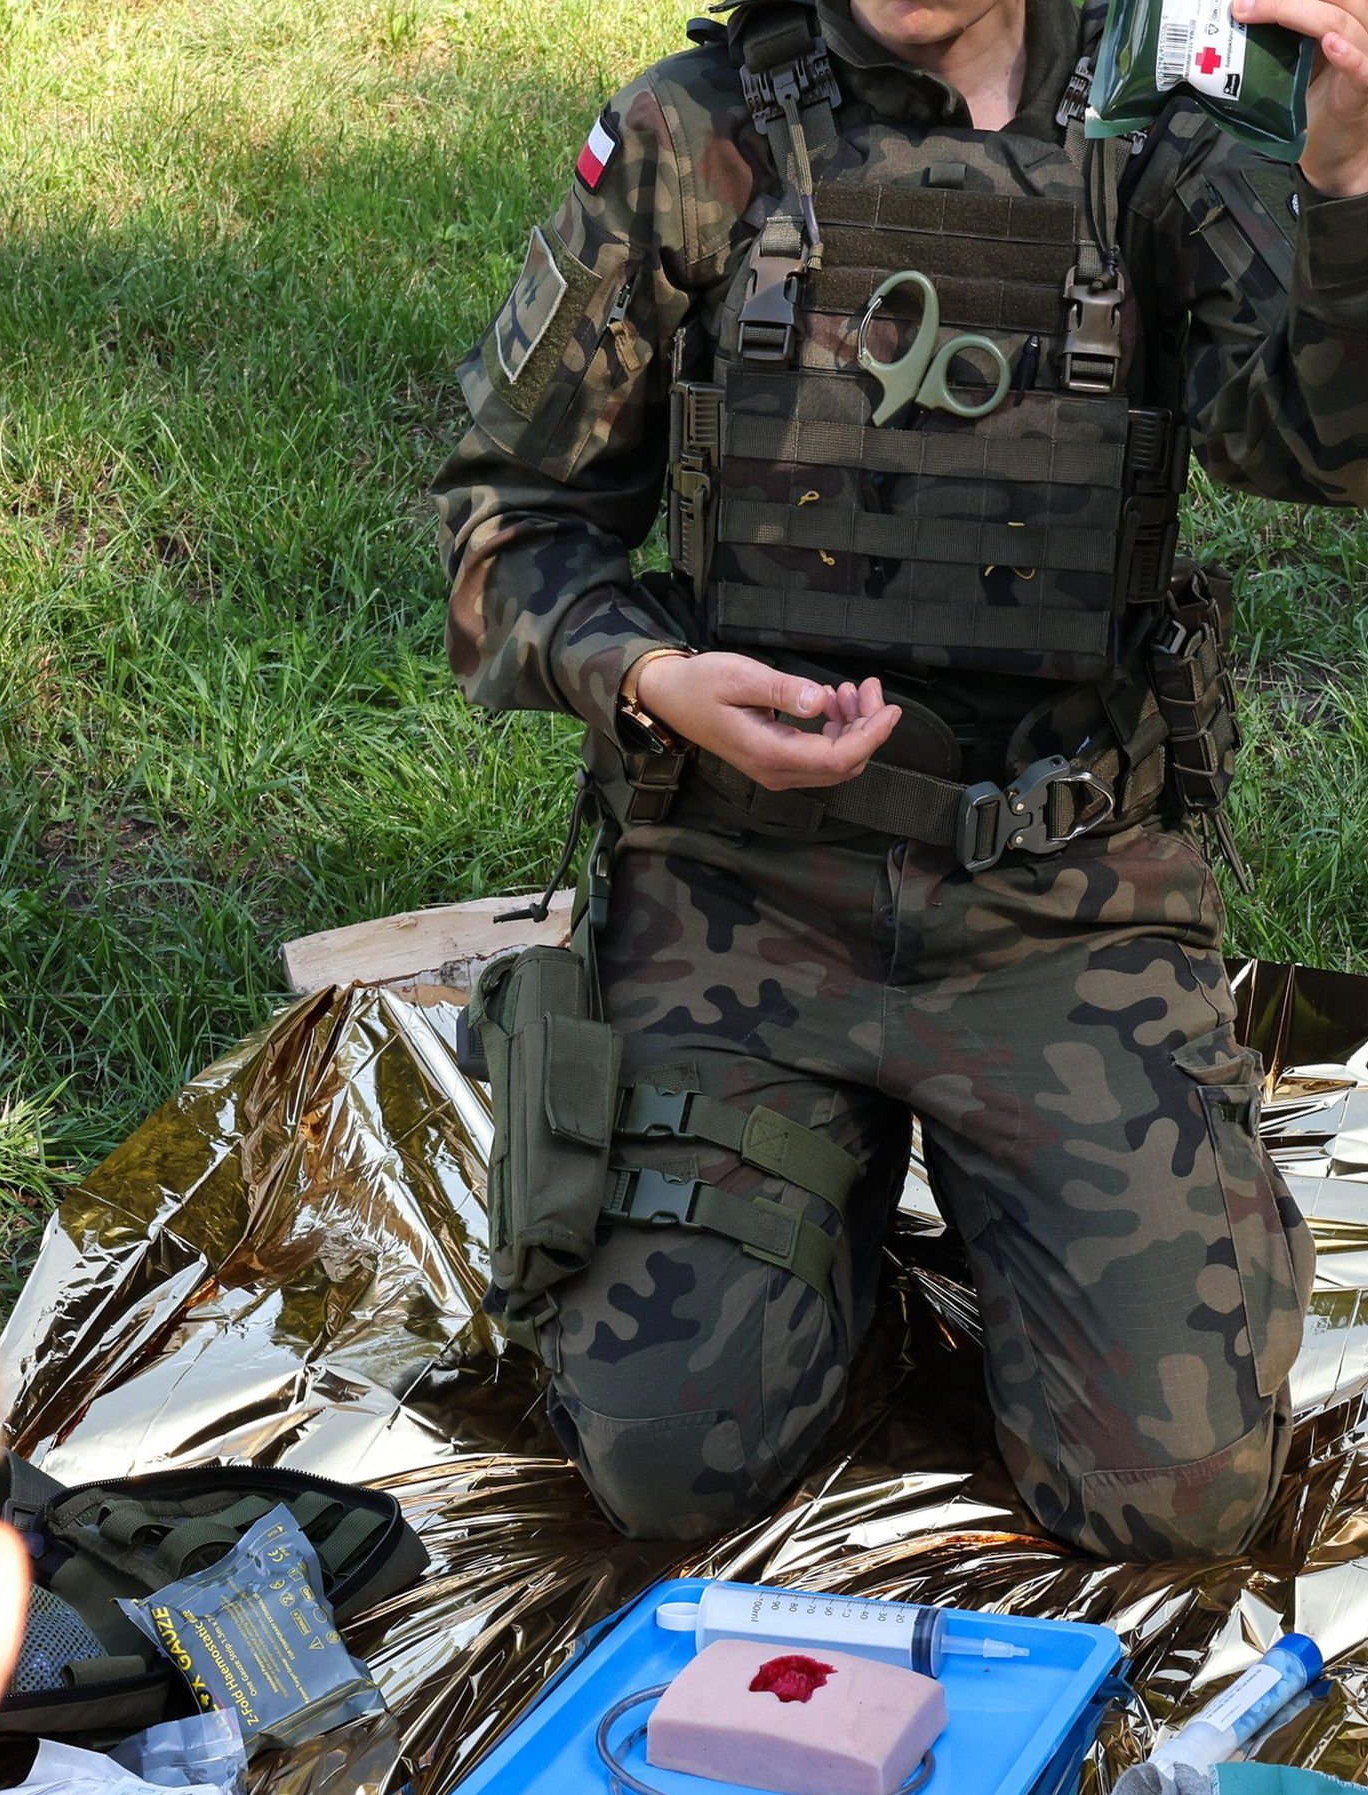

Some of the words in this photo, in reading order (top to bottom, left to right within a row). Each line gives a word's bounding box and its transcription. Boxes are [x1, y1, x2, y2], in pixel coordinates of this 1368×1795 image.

[770, 1600, 780, 1610] 90
[806, 1604, 815, 1614] 70
[859, 1609, 869, 1619] 40
[151, 1606, 193, 1670] GAUZE
[192, 1620, 239, 1690] Haemostatic
[221, 1641, 238, 1661] Strip
[231, 1659, 250, 1682] Gauze
[243, 1680, 258, 1697] One
[230, 1688, 259, 1725] Z-Fold
